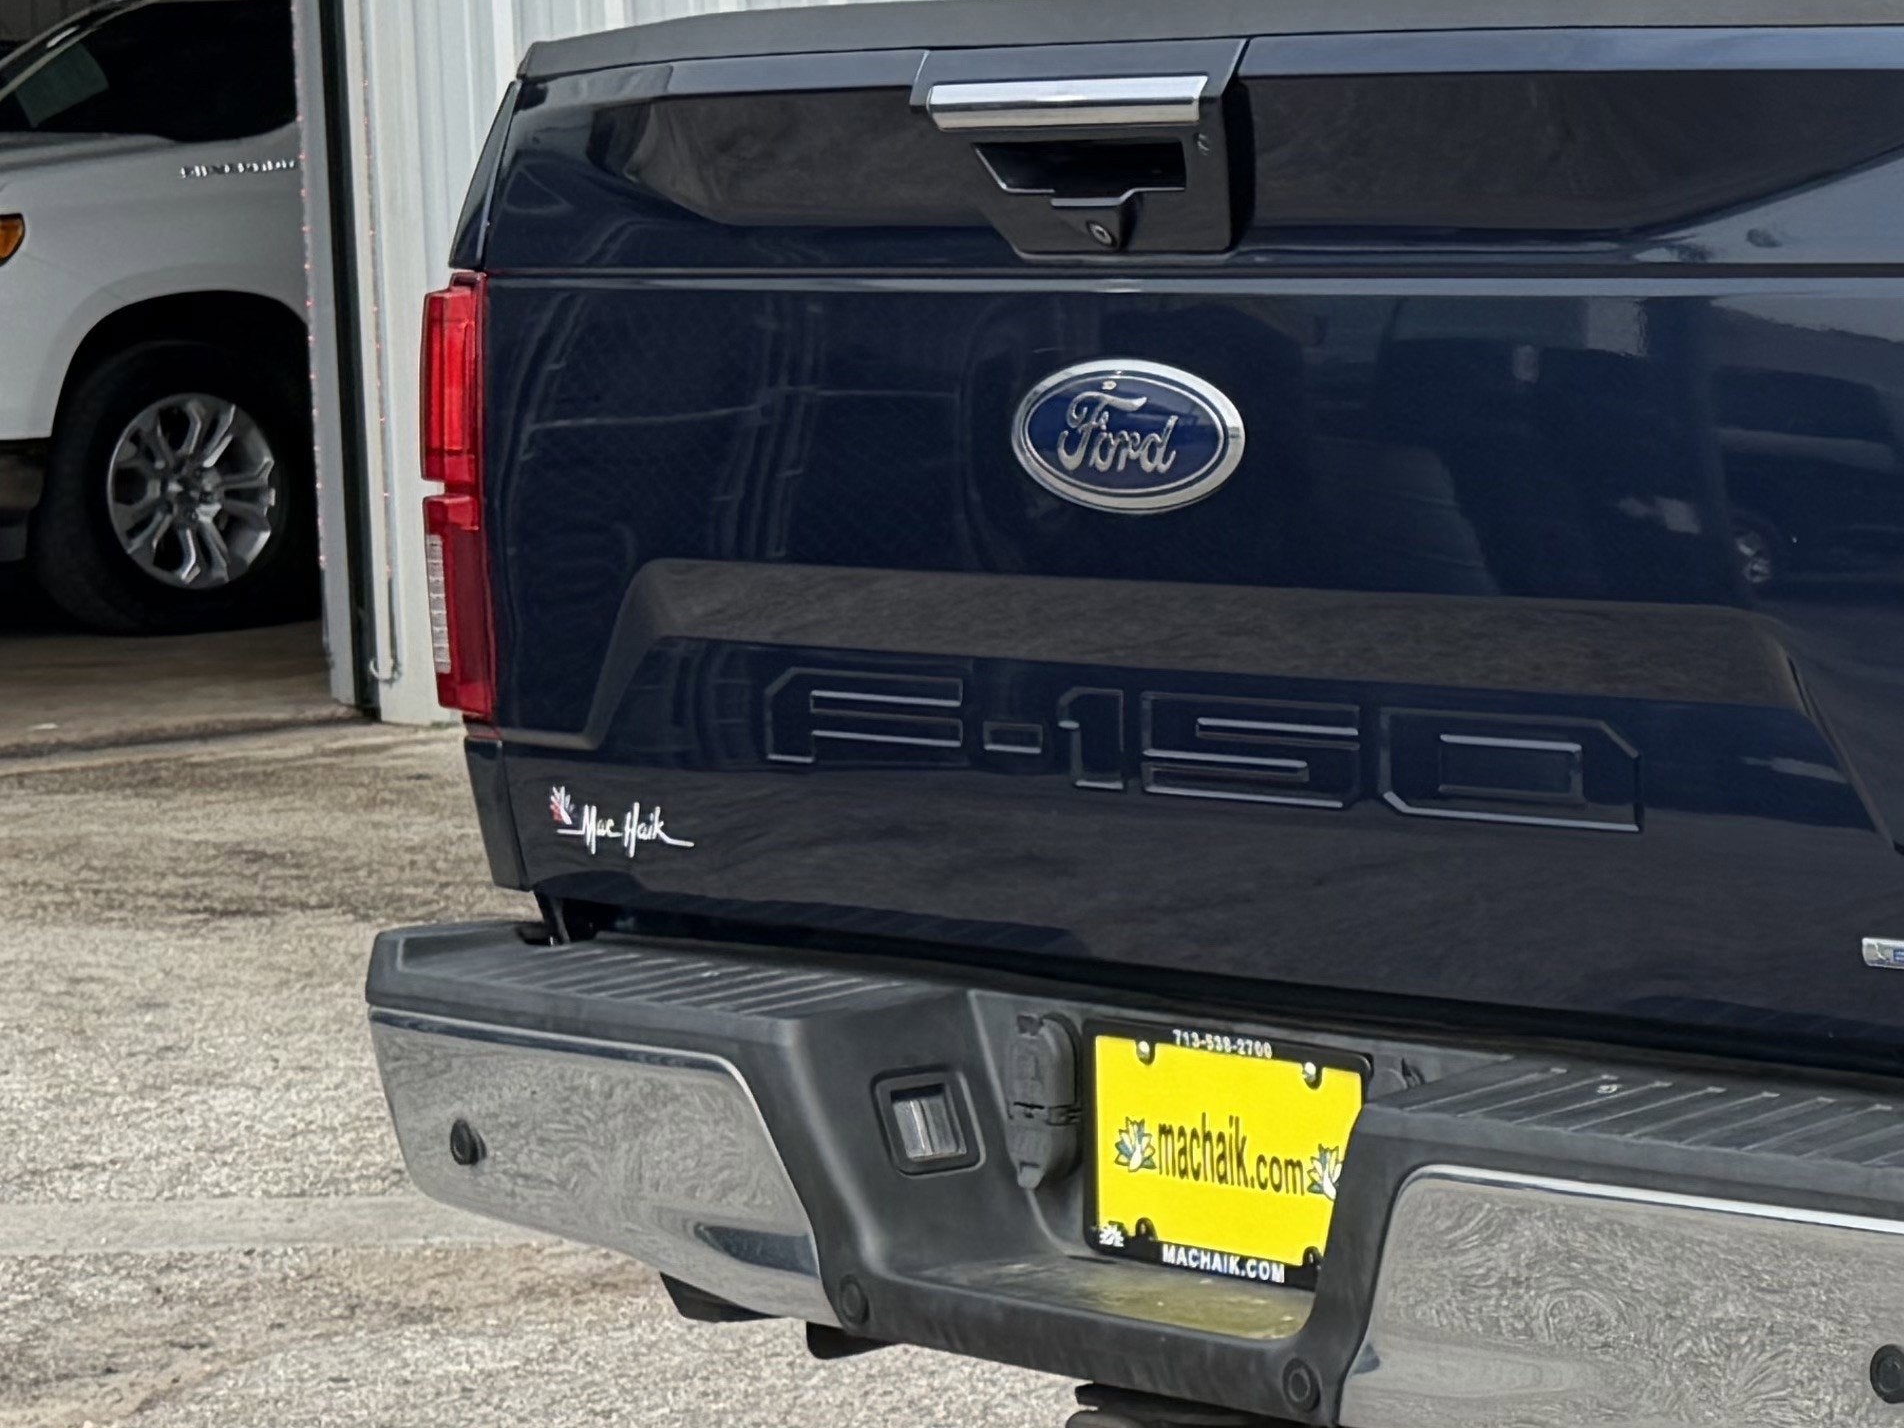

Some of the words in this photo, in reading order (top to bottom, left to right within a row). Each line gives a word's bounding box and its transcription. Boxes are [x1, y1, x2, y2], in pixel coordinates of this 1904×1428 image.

[1057, 390, 1179, 473] Ford
[764, 666, 1643, 833] F-150
[557, 804, 623, 855] Mac
[624, 801, 695, 858] Haik
[1158, 1111, 1305, 1196] machaik.com
[1162, 1243, 1285, 1283] MACHAIK.COM
